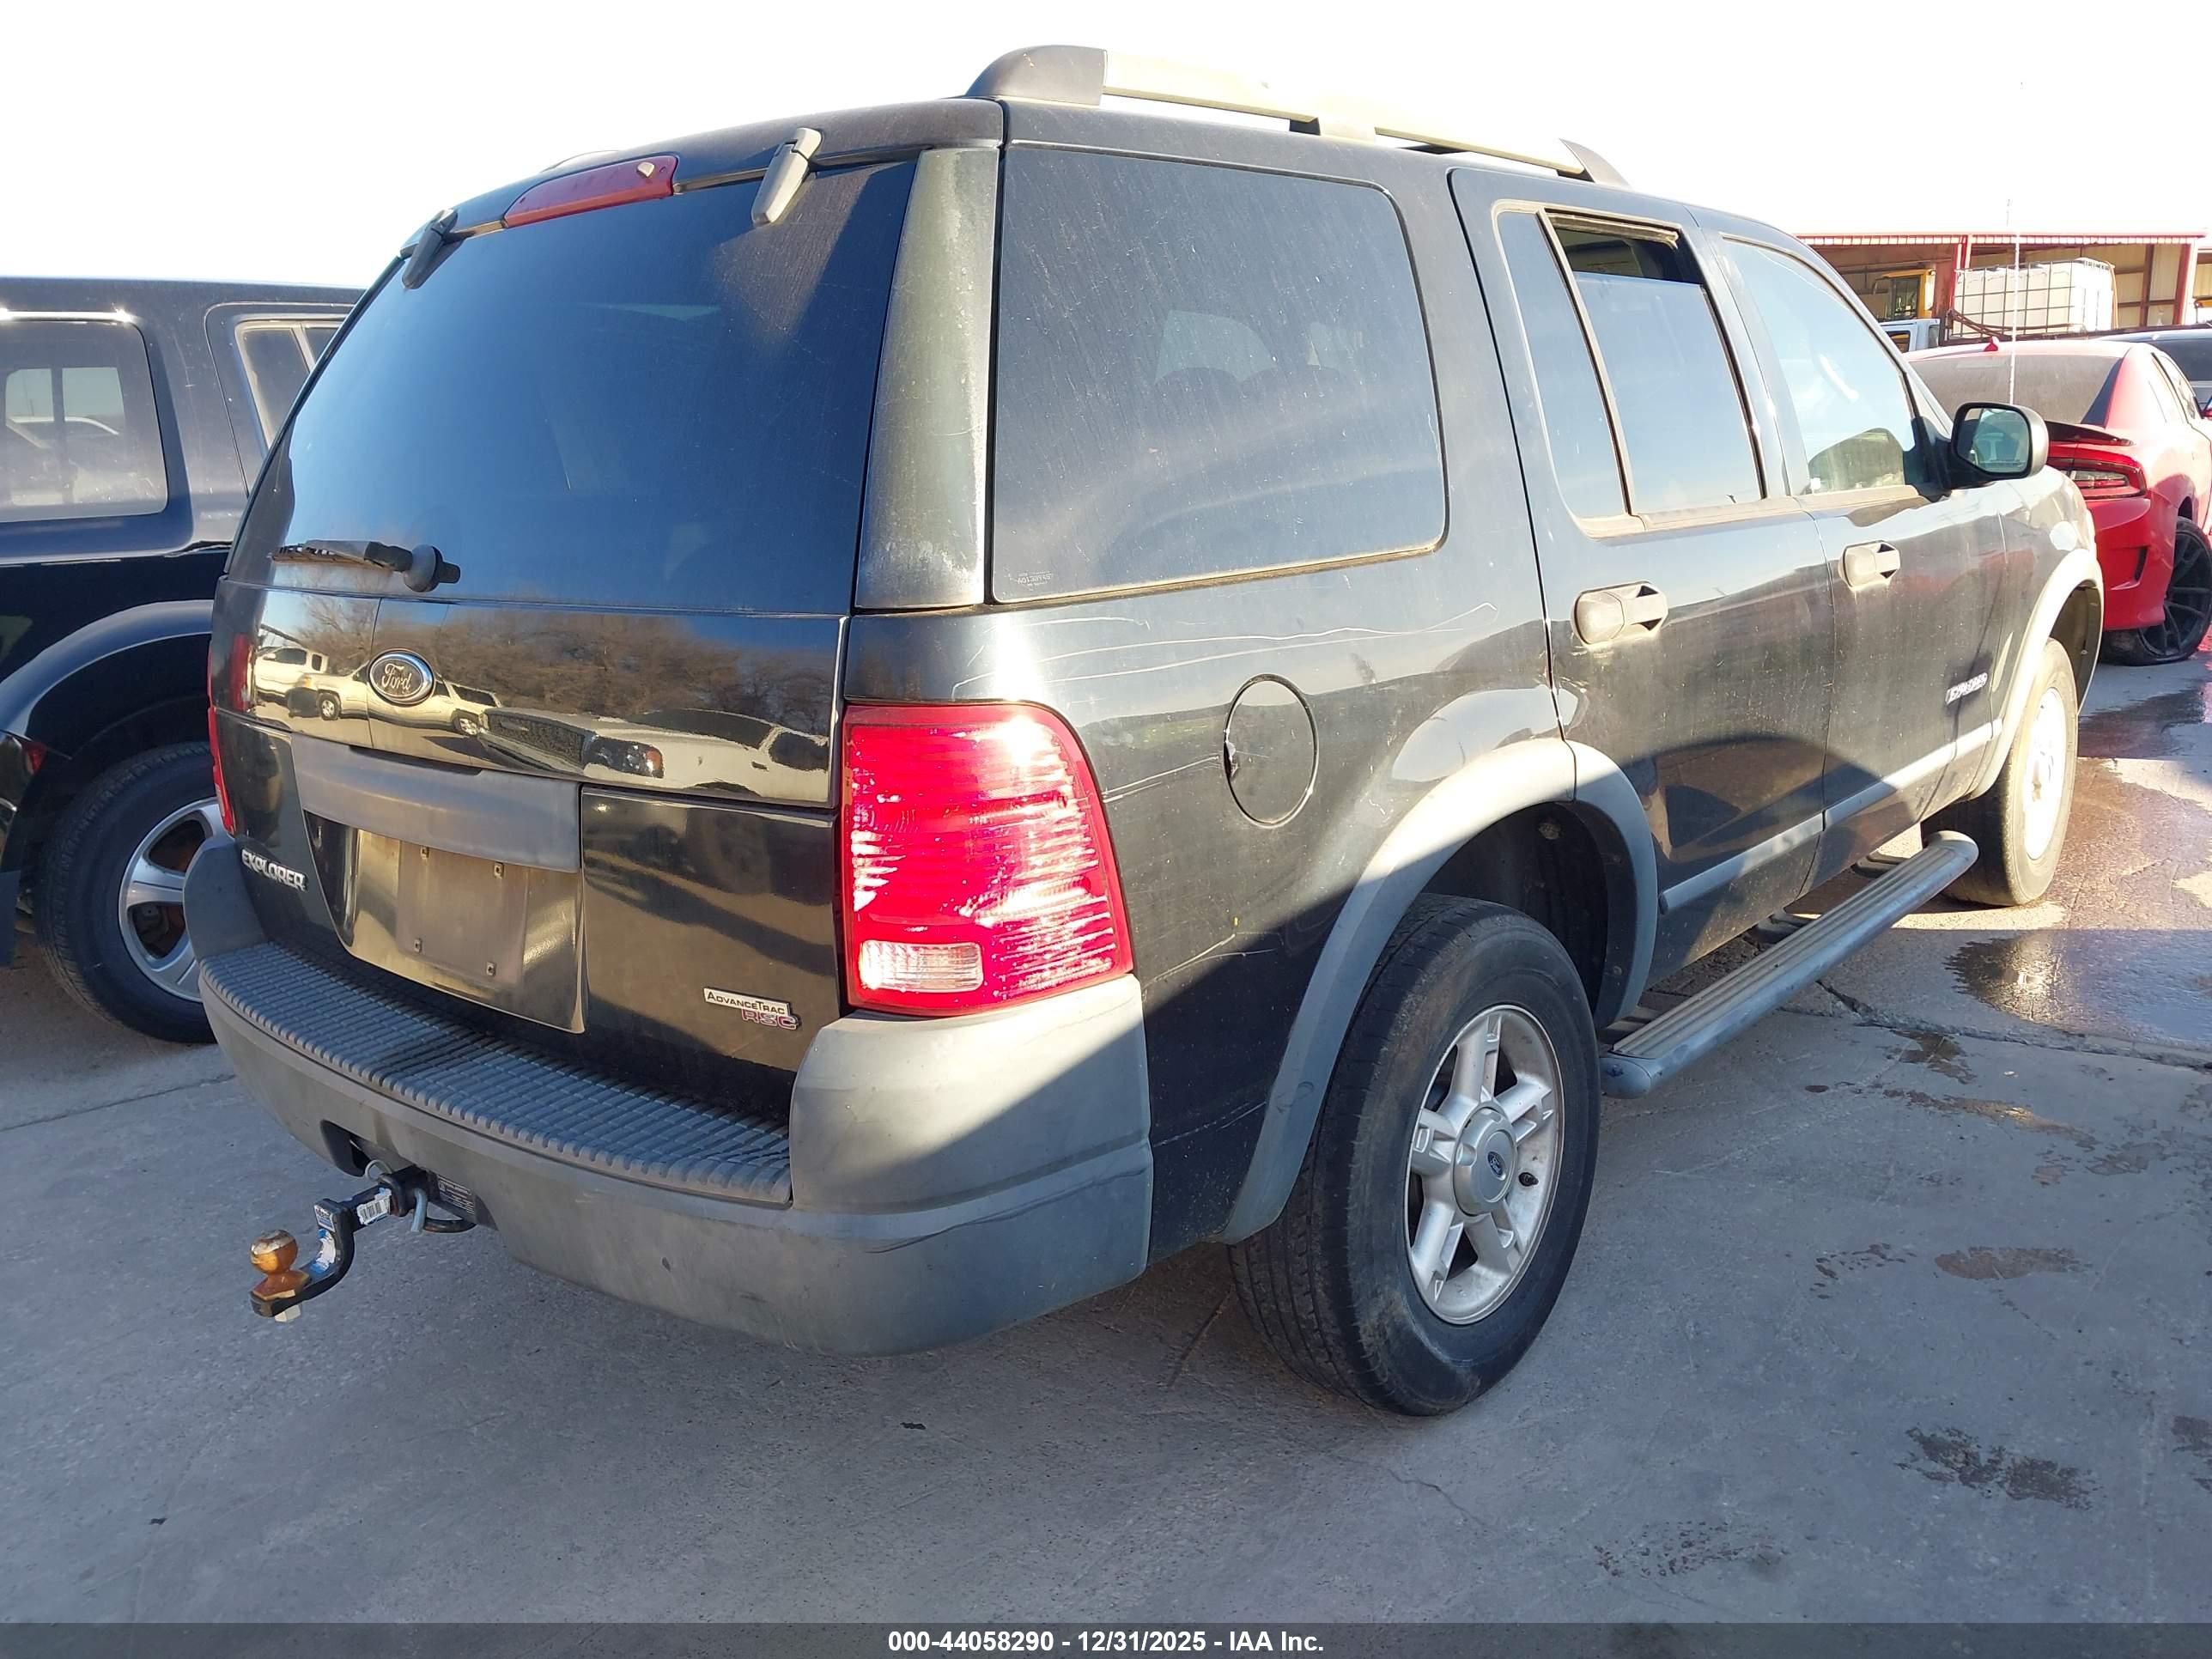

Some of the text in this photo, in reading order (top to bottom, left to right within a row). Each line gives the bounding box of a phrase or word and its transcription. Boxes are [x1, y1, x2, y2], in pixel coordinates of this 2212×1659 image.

[381, 663, 412, 690] Ford
[241, 848, 307, 892] EXPLORER
[741, 1008, 799, 1030] RSC
